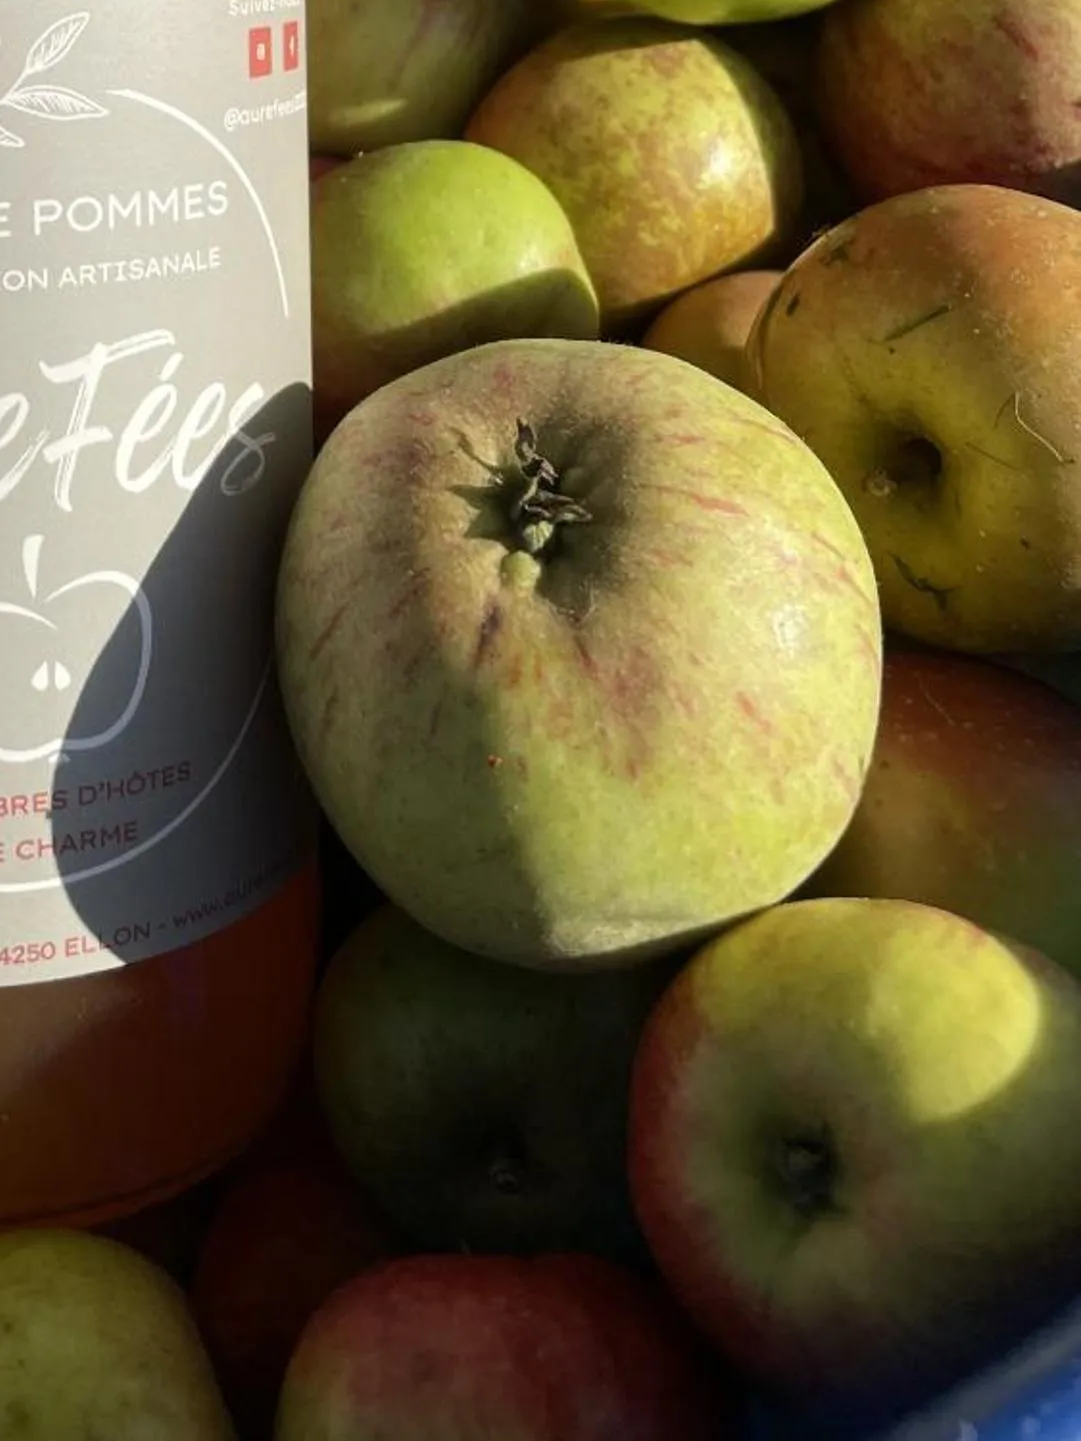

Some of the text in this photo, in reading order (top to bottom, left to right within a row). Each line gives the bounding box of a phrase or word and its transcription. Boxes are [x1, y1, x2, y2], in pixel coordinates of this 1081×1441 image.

[33, 180, 229, 236] POMMES
[58, 246, 222, 289] ARTISANALE
[78, 761, 192, 807] D'HÔTES
[15, 821, 139, 861] CHARME
[64, 921, 152, 956] ELLON
